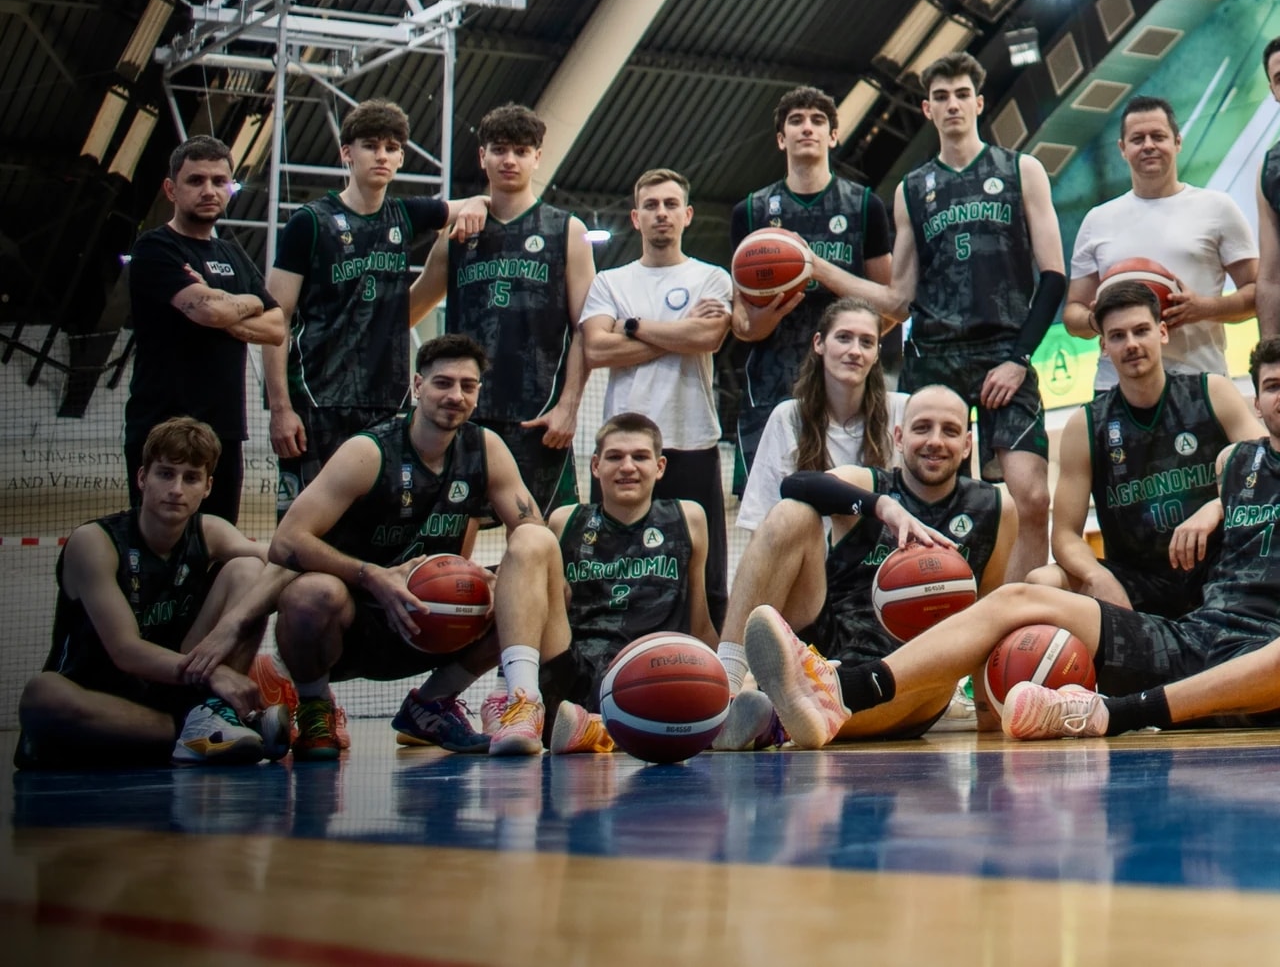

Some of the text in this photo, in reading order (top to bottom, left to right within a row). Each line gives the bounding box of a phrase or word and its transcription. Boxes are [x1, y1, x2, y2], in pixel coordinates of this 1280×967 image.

[922, 201, 1012, 243] AGRONOMIA
[955, 233, 971, 261] 5
[456, 258, 549, 288] AGRONOMIA
[362, 274, 376, 301] 3
[1150, 499, 1185, 533] 10
[567, 555, 679, 583] AGRONOMIA
[609, 584, 630, 610] 2
